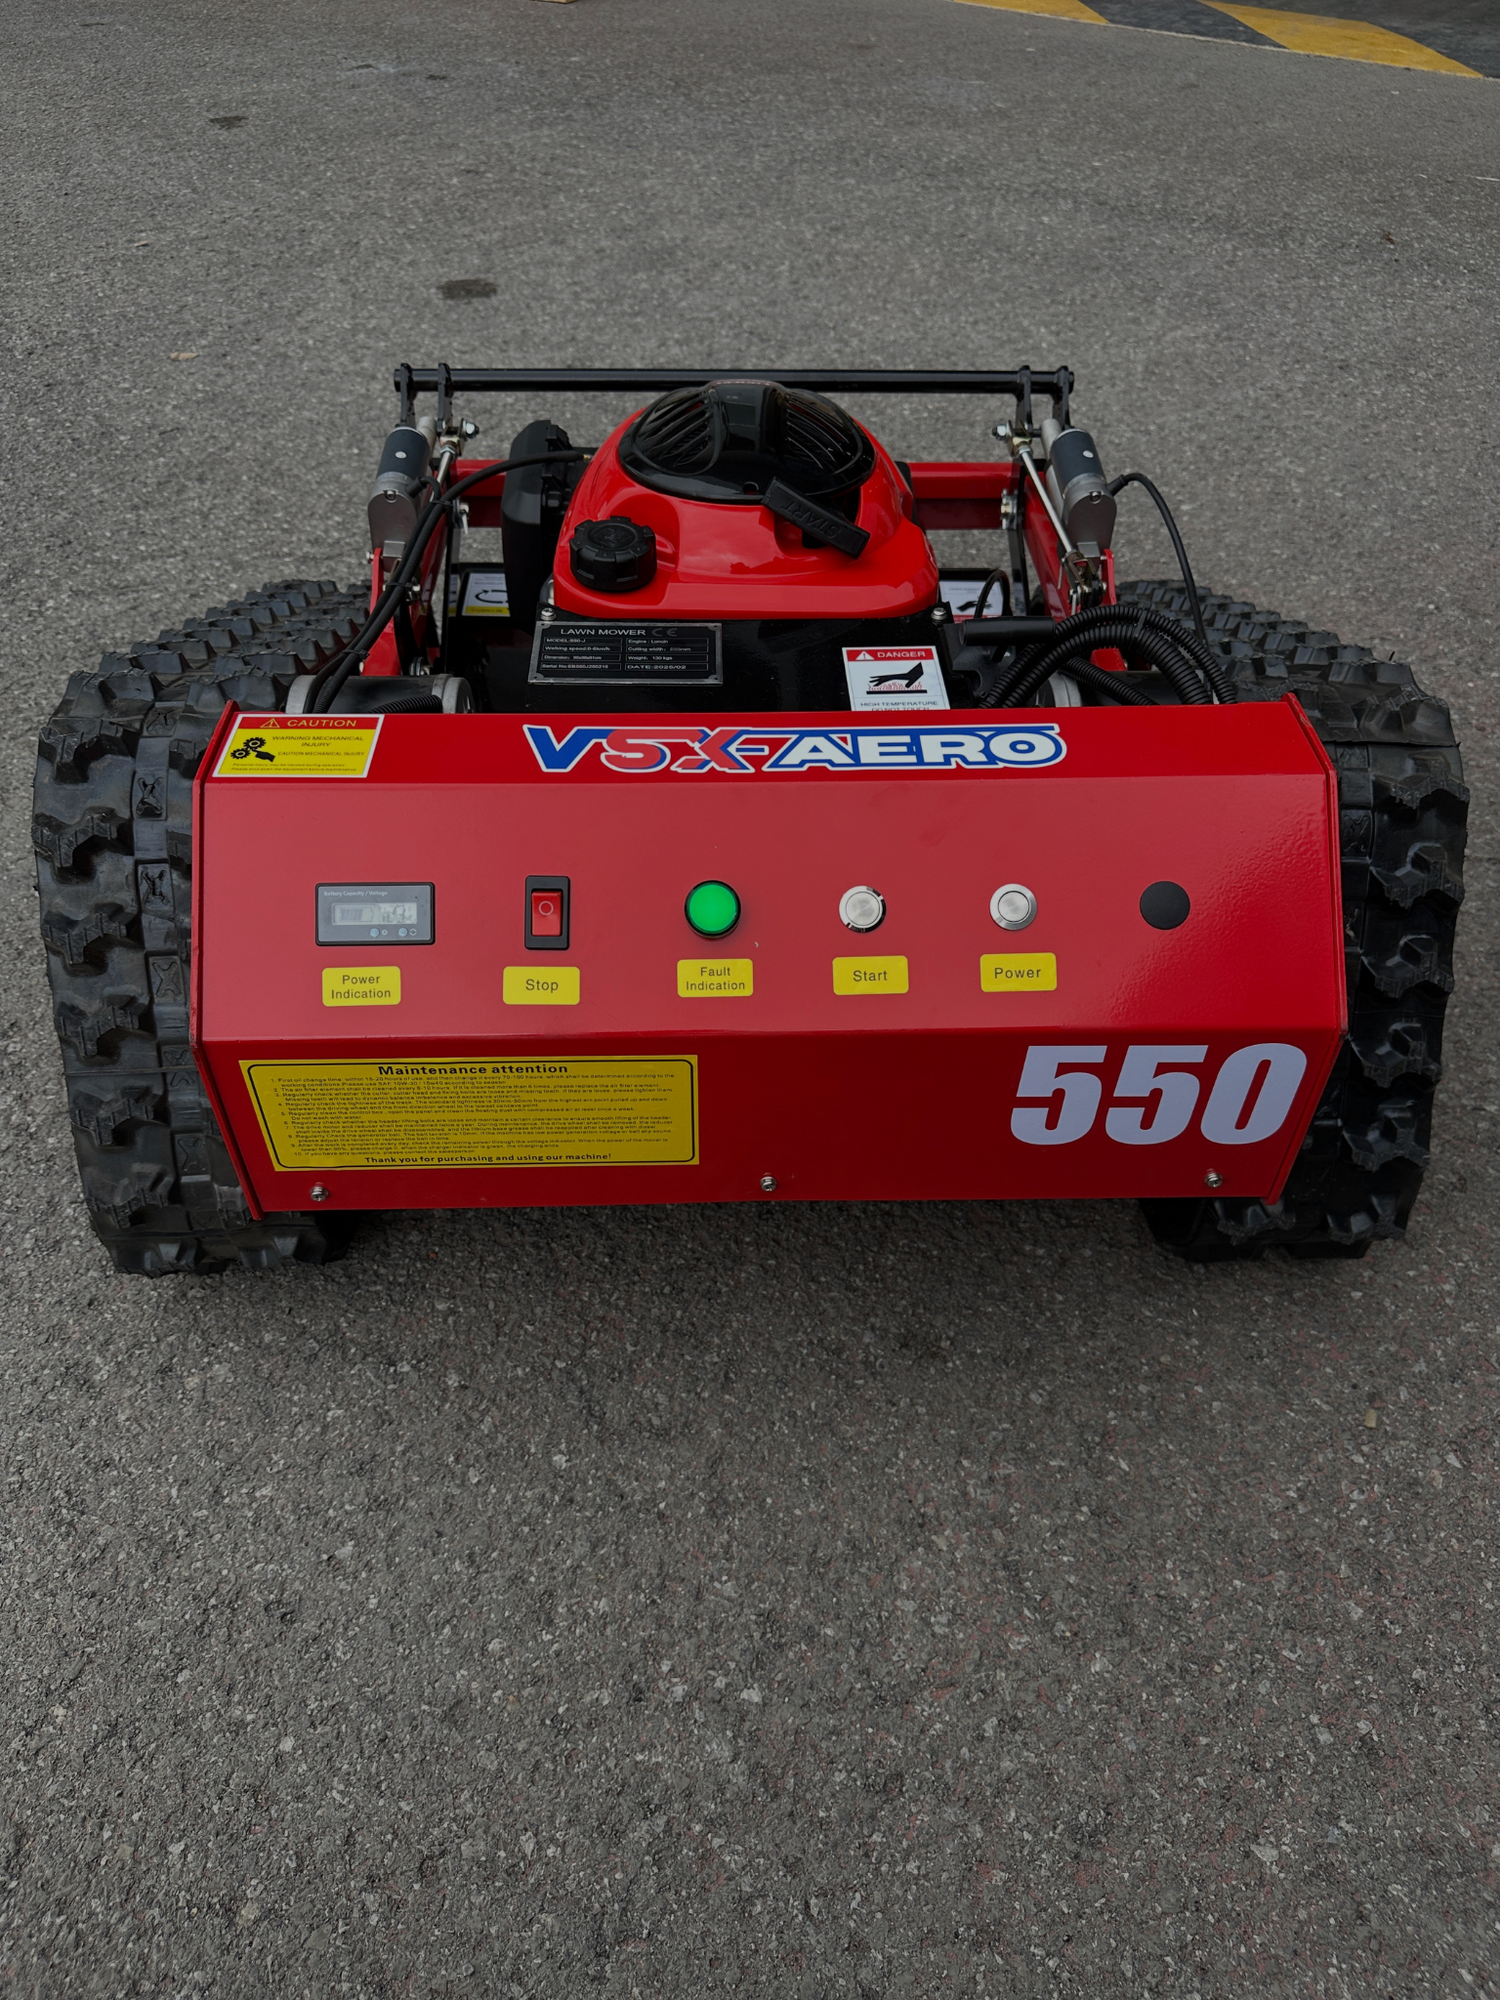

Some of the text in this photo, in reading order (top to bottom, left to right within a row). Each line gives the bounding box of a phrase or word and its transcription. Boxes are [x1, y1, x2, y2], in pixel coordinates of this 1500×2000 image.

[782, 501, 842, 539] START
[877, 651, 926, 659] DANGER
[287, 719, 358, 728] CAUTION
[523, 724, 1066, 773] VSX-AERO
[324, 890, 342, 898] Battery
[343, 890, 364, 898] Capacity
[700, 967, 731, 977] Fault
[853, 970, 888, 982] Start
[994, 967, 1042, 979] Power
[342, 975, 381, 985] Power
[525, 978, 564, 993] Stop
[686, 981, 745, 991] Indication
[331, 989, 391, 999] Indication
[378, 1063, 568, 1075] Maintenance attention
[1010, 1043, 1308, 1146] 550
[365, 1156, 397, 1164] Thank
[399, 1157, 417, 1165] you
[438, 1155, 493, 1165] purchasing
[496, 1154, 514, 1162] and
[517, 1154, 543, 1163] using
[566, 1152, 611, 1161] machine!
